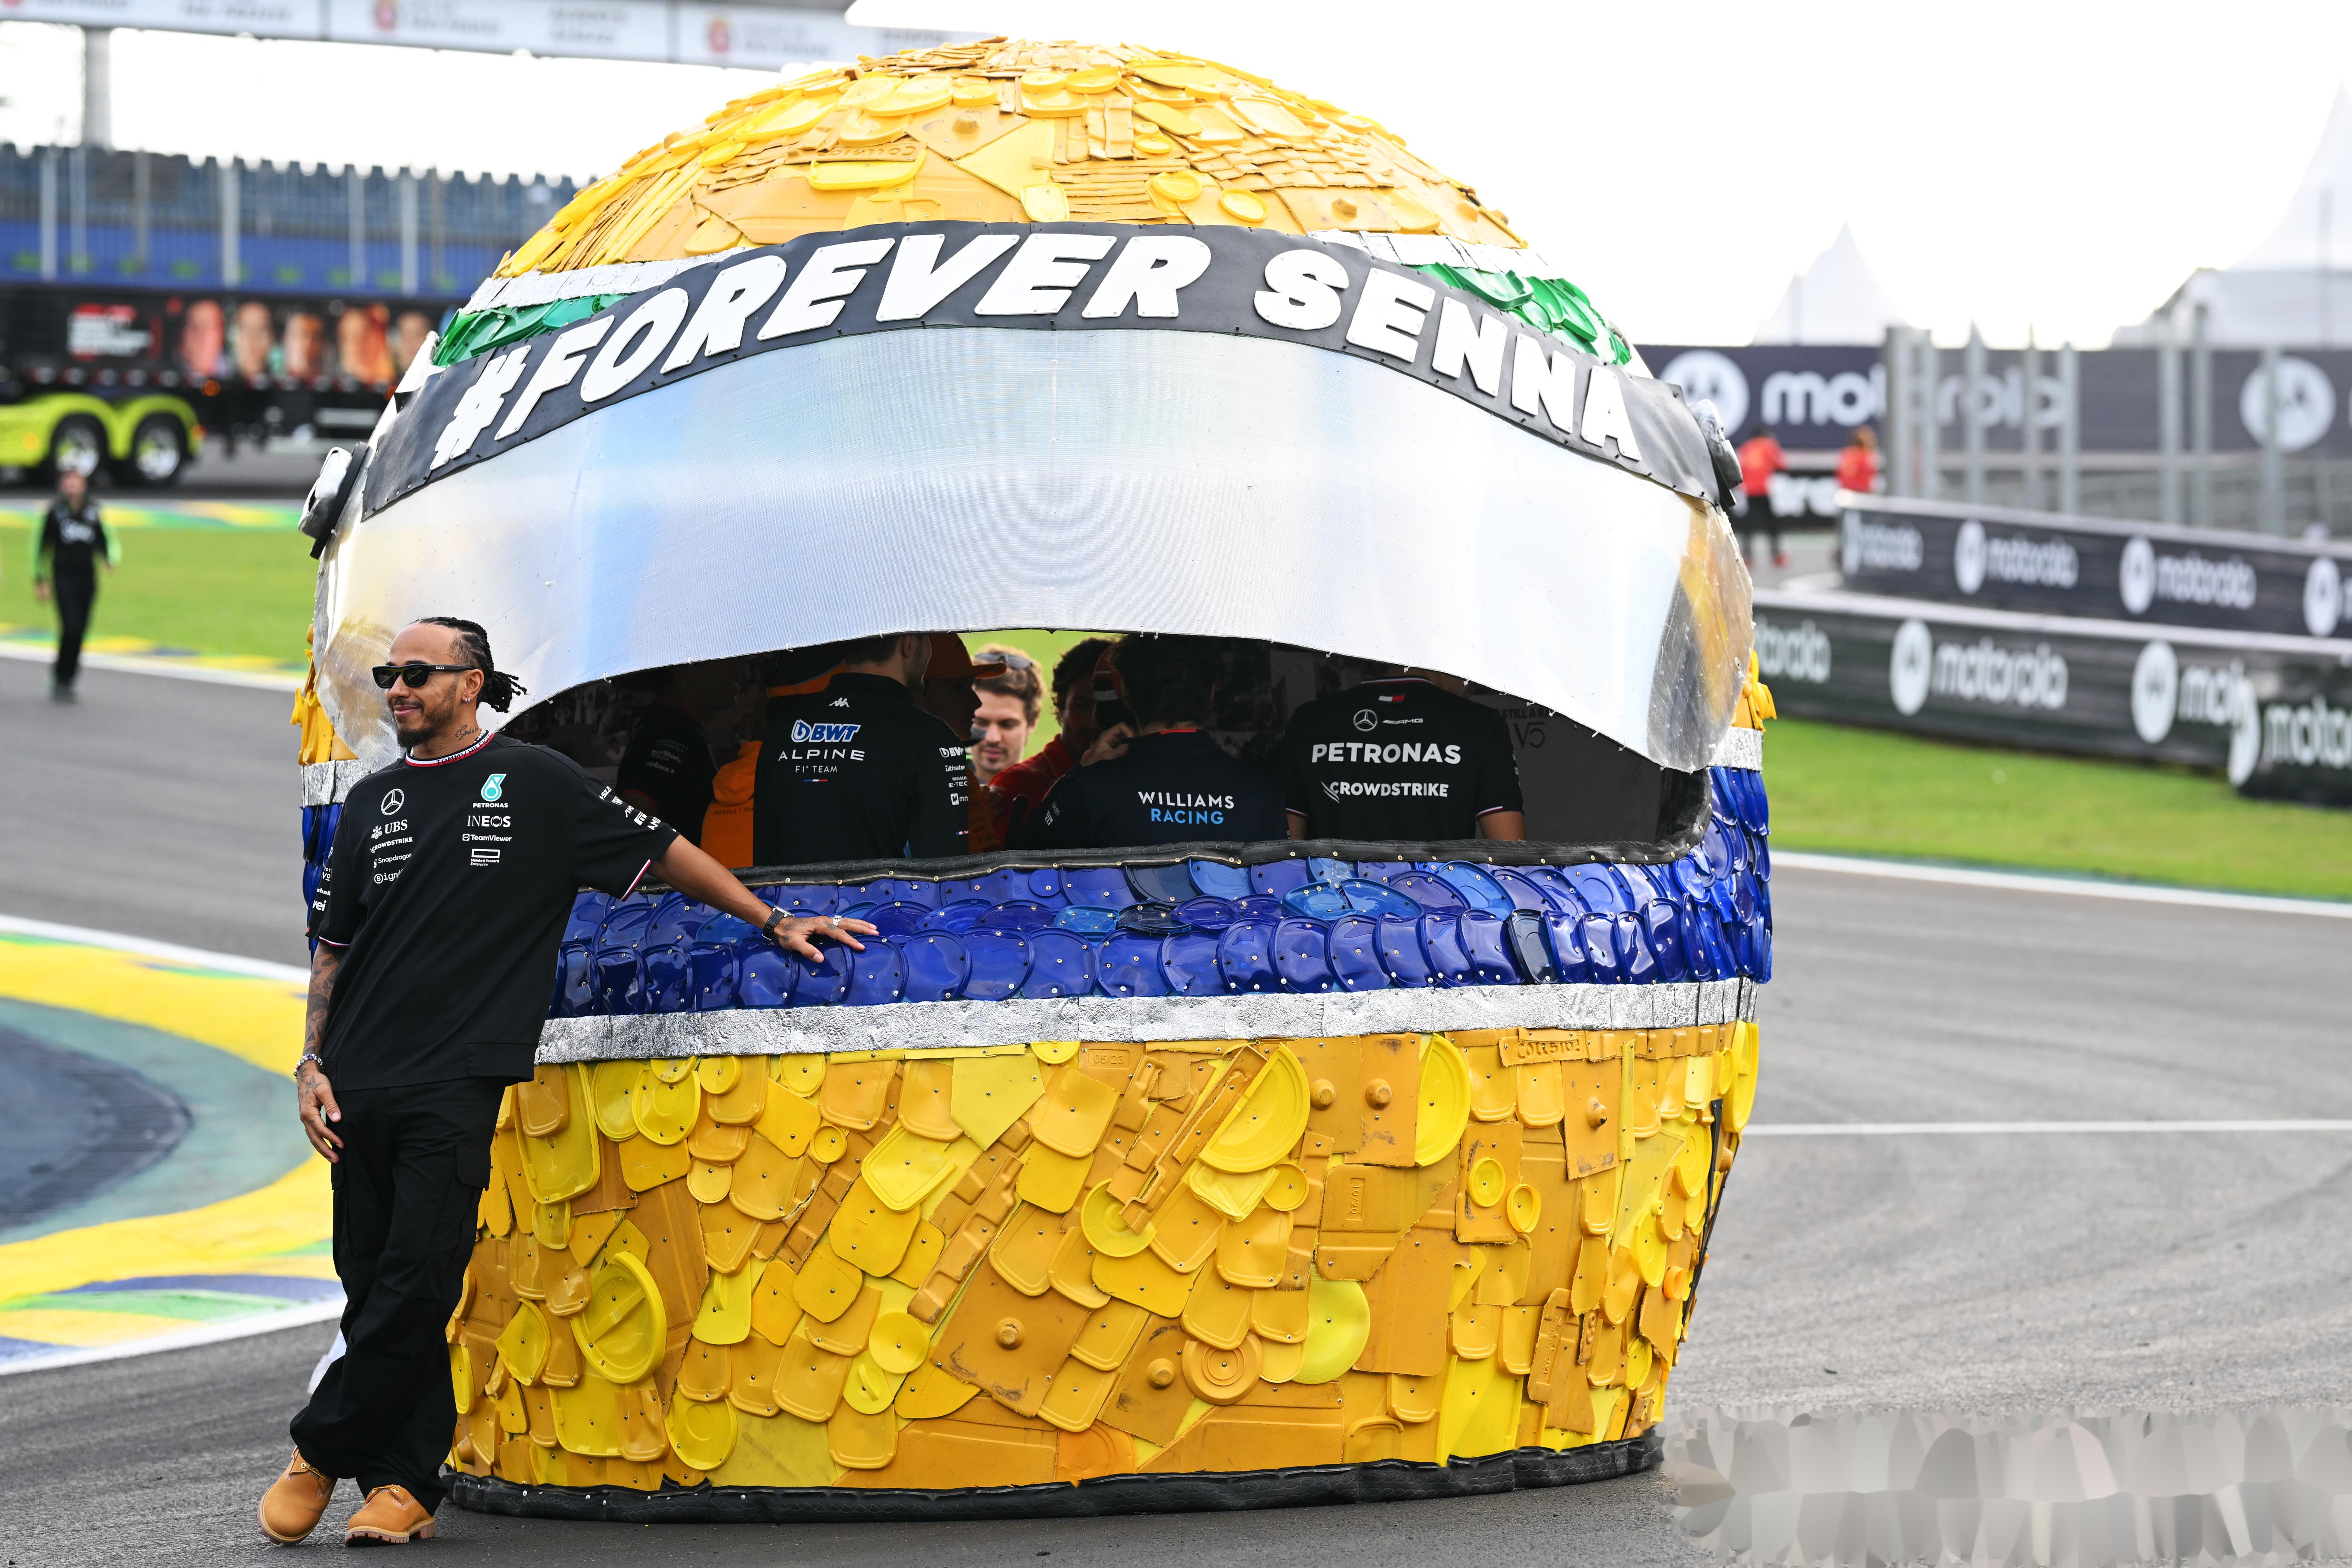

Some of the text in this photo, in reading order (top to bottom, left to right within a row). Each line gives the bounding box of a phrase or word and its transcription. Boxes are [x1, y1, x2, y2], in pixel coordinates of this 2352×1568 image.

[430, 232, 1641, 470] #FOREVER SENNA
[1935, 637, 2069, 711] motorola
[809, 723, 861, 742] BWT
[436, 751, 467, 765] TOMMY
[778, 749, 865, 762] ALPINE
[1312, 742, 1461, 764] PETRONAS
[812, 765, 837, 774] TEAM
[1328, 781, 1449, 798] CROWDSTRIKE
[1137, 791, 1234, 810] WILLIAMS
[467, 815, 511, 828] INEOS
[1151, 808, 1224, 825] RACING
[384, 819, 408, 834] UBS
[371, 837, 413, 852] CROWDSTRIKE
[378, 852, 412, 864] Snapdragon
[1093, 1054, 1125, 1065] 05/23
